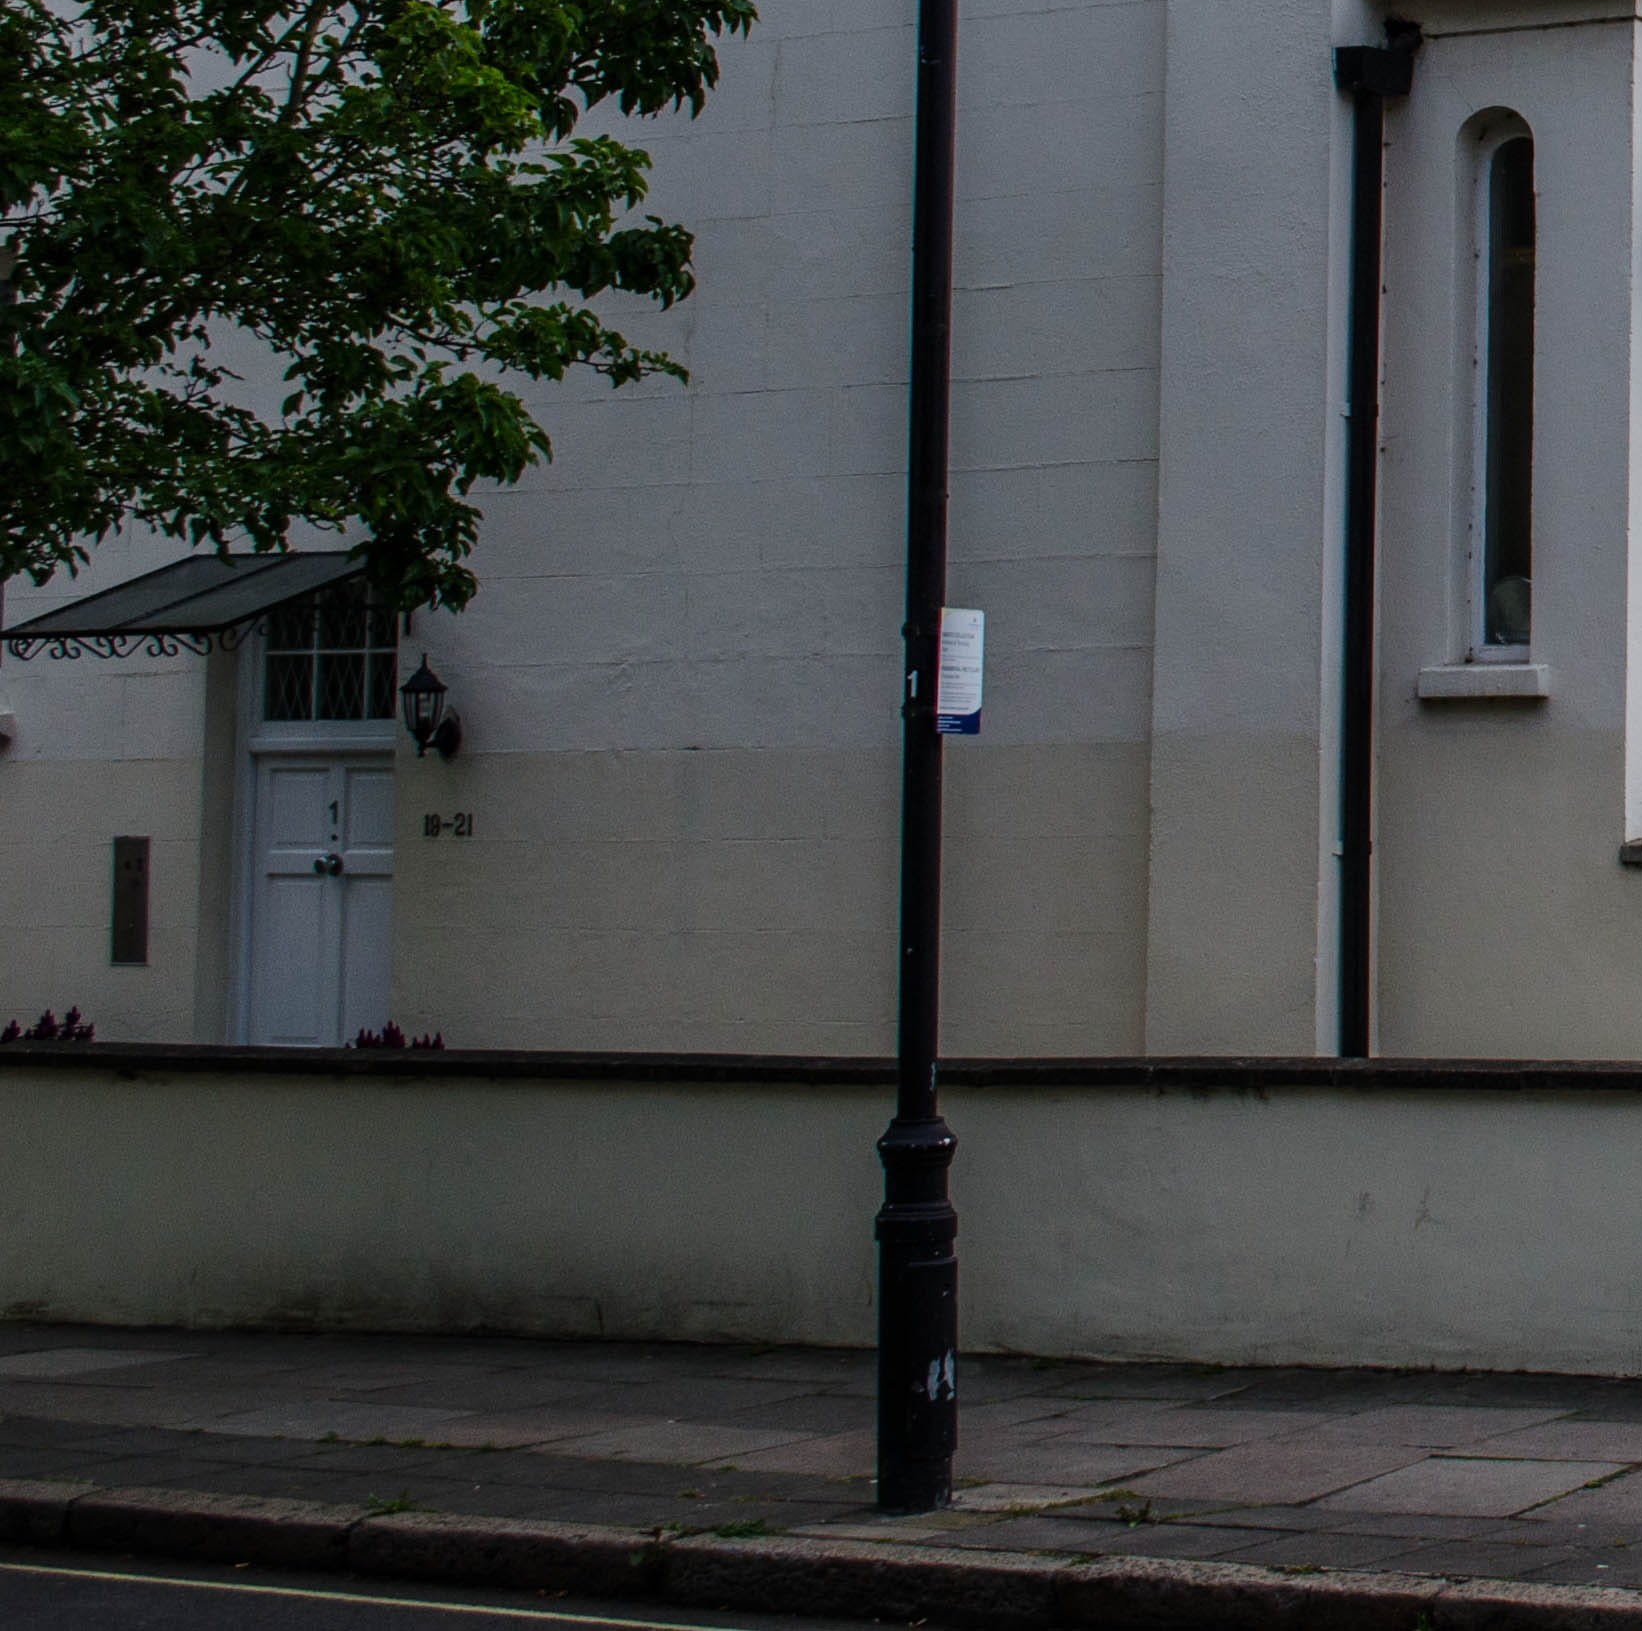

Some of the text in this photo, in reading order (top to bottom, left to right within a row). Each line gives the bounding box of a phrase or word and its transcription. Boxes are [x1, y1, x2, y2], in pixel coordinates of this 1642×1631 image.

[906, 669, 919, 699] 1
[328, 799, 339, 825] 1
[423, 812, 474, 837] 19-21
